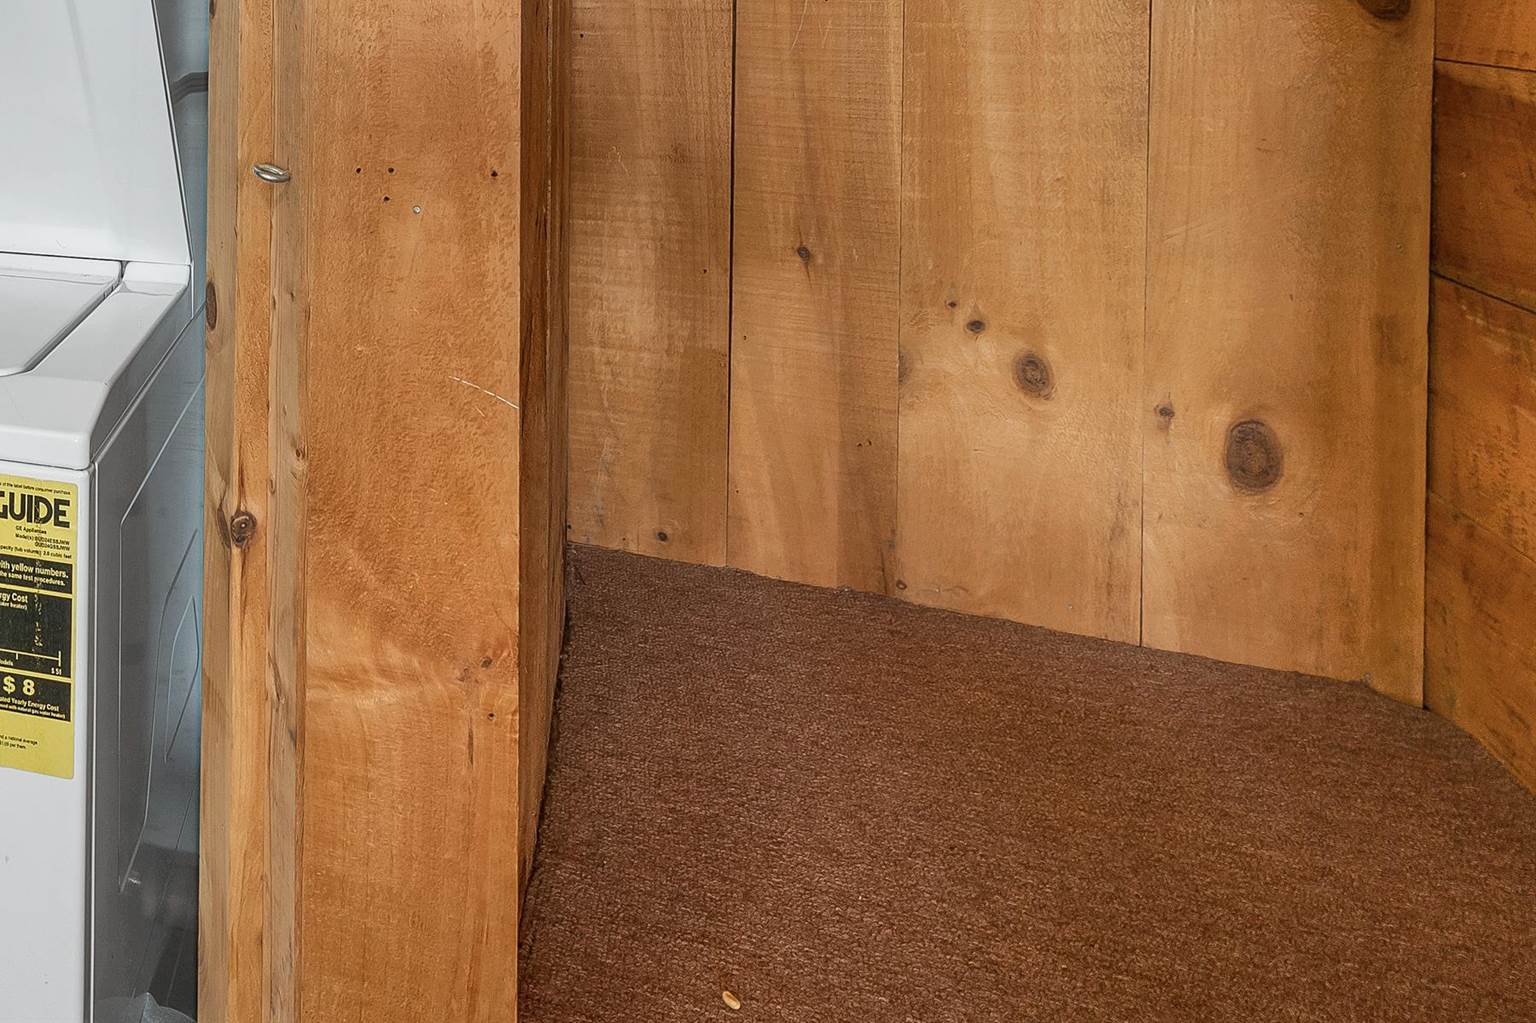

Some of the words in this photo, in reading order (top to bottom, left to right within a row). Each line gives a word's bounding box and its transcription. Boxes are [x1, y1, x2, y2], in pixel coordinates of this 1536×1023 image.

[11, 562, 34, 573] yellow
[35, 567, 69, 578] numbers.
[11, 593, 28, 603] Cost
[12, 697, 27, 707] Yearly
[28, 701, 46, 710] Energy
[46, 704, 59, 712] Cost
